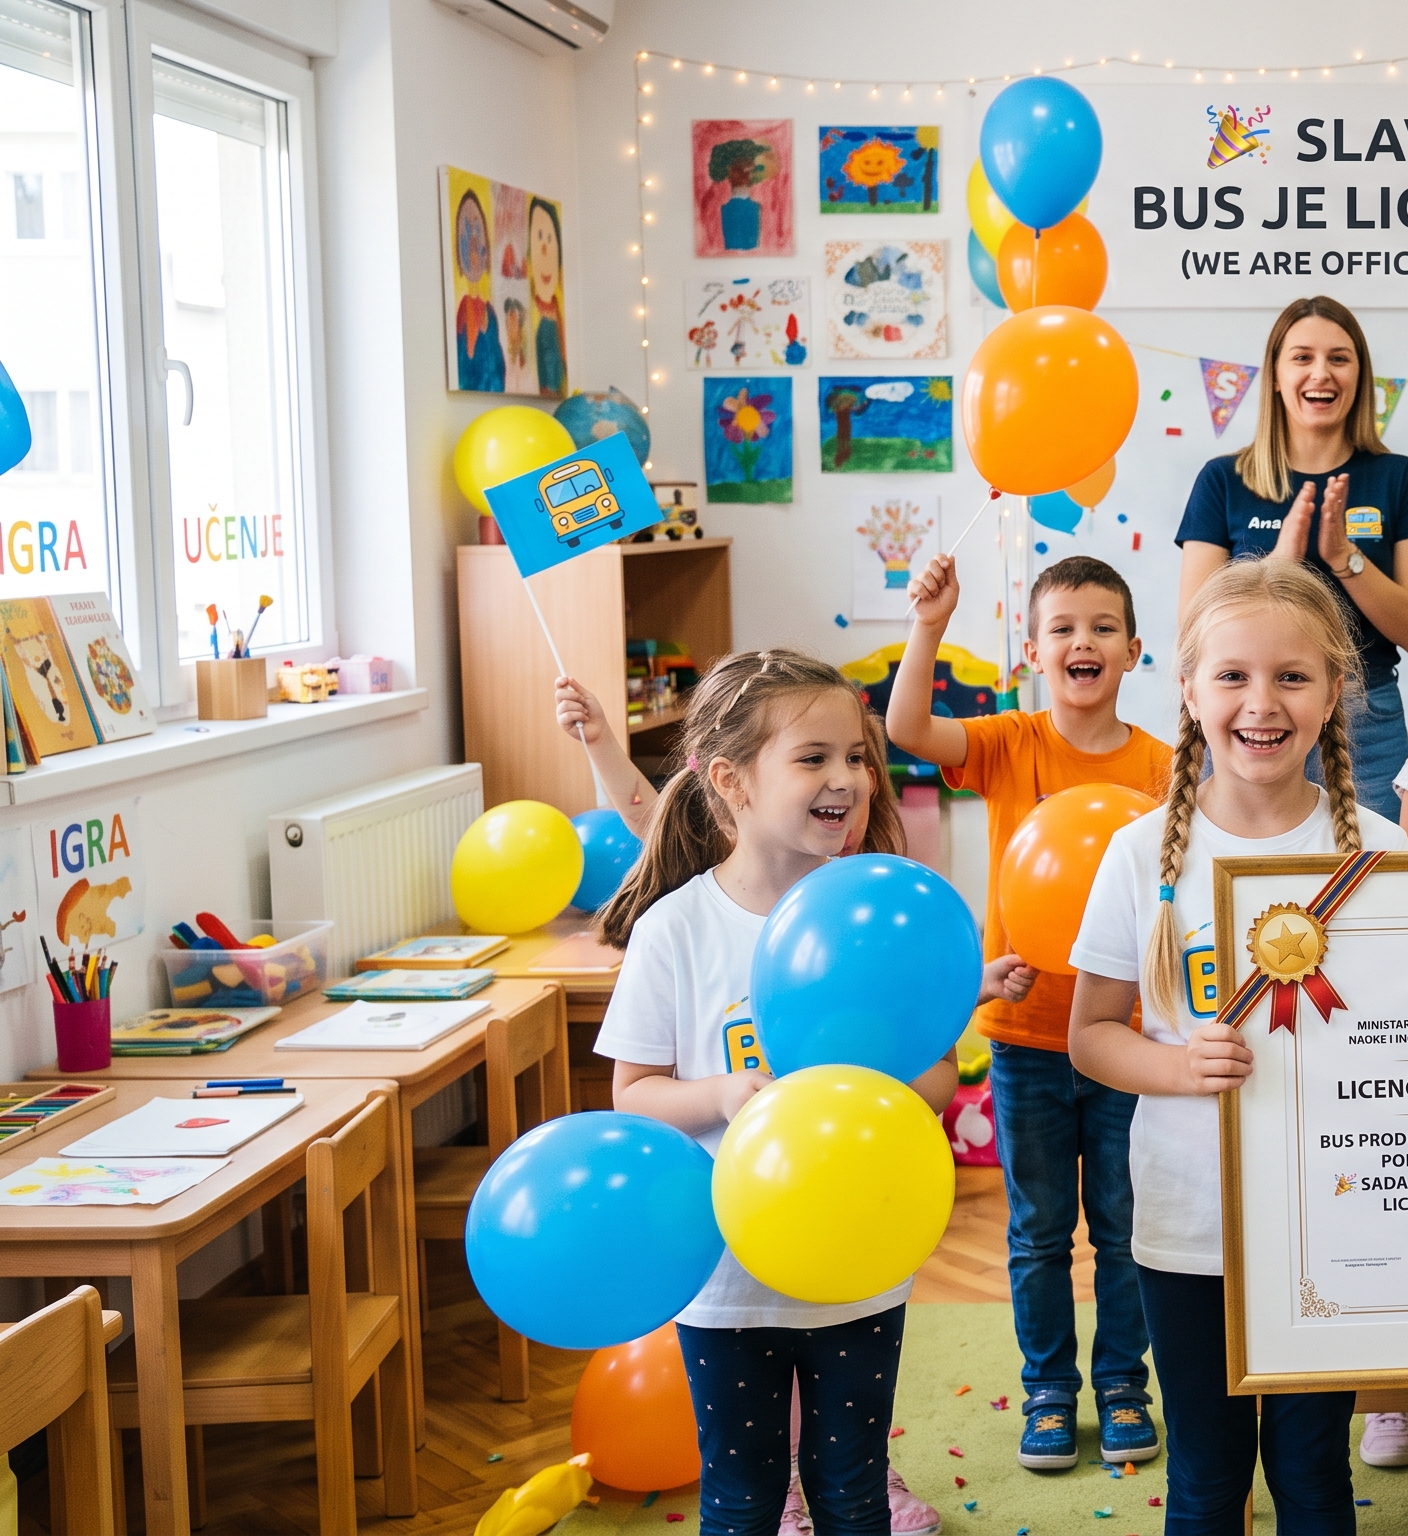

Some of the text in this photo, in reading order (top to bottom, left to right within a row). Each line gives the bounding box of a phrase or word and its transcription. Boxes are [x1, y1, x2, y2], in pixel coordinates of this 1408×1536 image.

[1134, 185, 1245, 231] BUS
[1262, 185, 1325, 231] JE
[1181, 249, 1241, 280] (WE
[1249, 251, 1312, 275] ARE
[1213, 371, 1238, 400] S
[183, 503, 284, 563] UČENJE
[1248, 516, 1281, 530] Ana
[50, 813, 130, 878] IGRA
[1320, 1133, 1354, 1149] BUS
[1361, 1175, 1408, 1191] SADA
